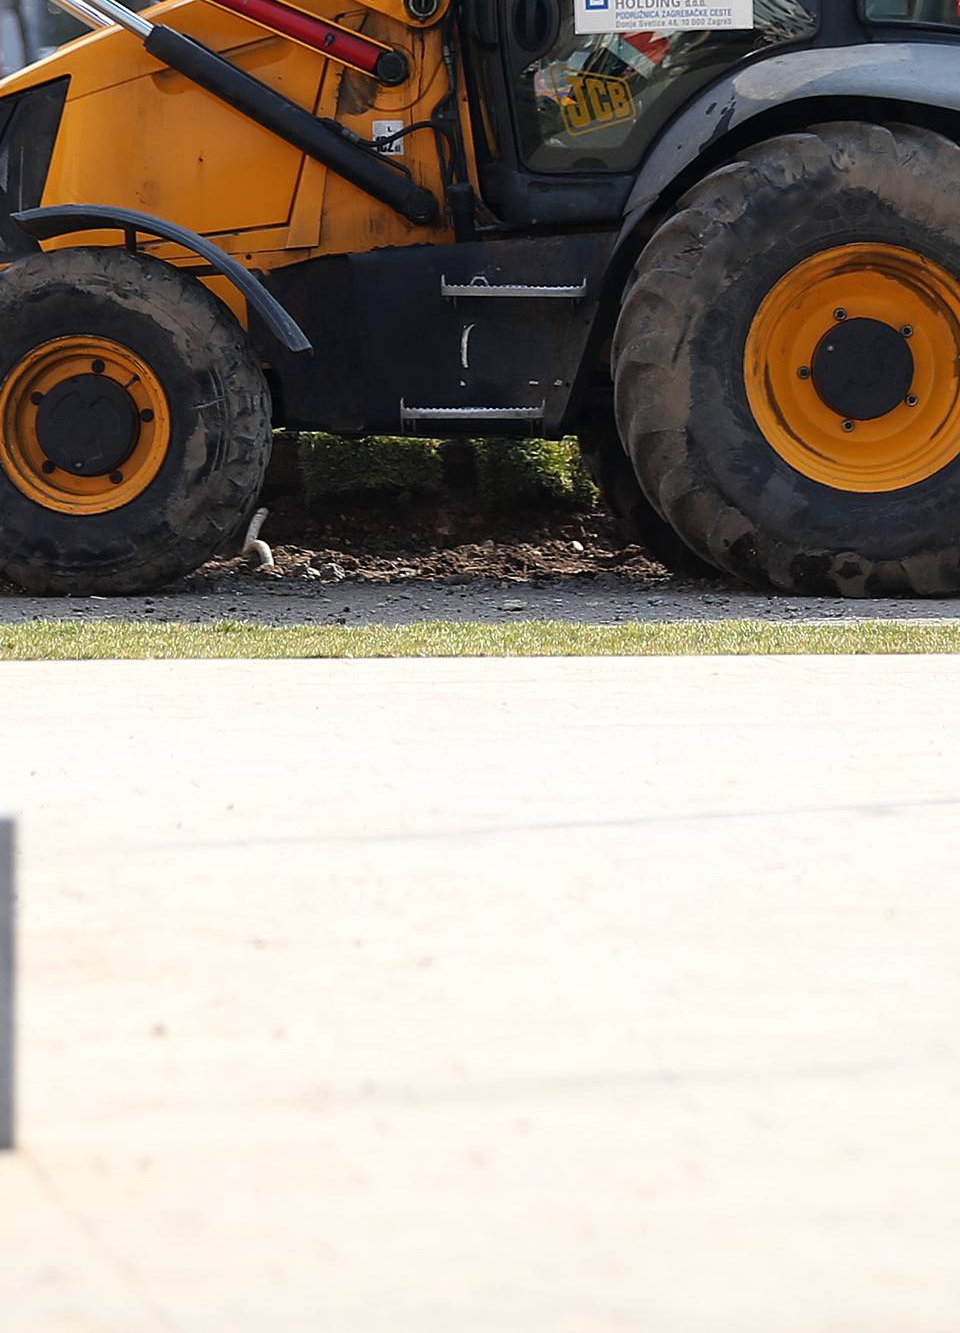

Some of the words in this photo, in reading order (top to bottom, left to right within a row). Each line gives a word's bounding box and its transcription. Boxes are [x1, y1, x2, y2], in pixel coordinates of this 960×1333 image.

[616, 10, 660, 19] PODRUŽNICA
[662, 8, 708, 18] ZAGREBAČKE
[710, 8, 732, 17] CESTE
[566, 74, 631, 128] JCB
